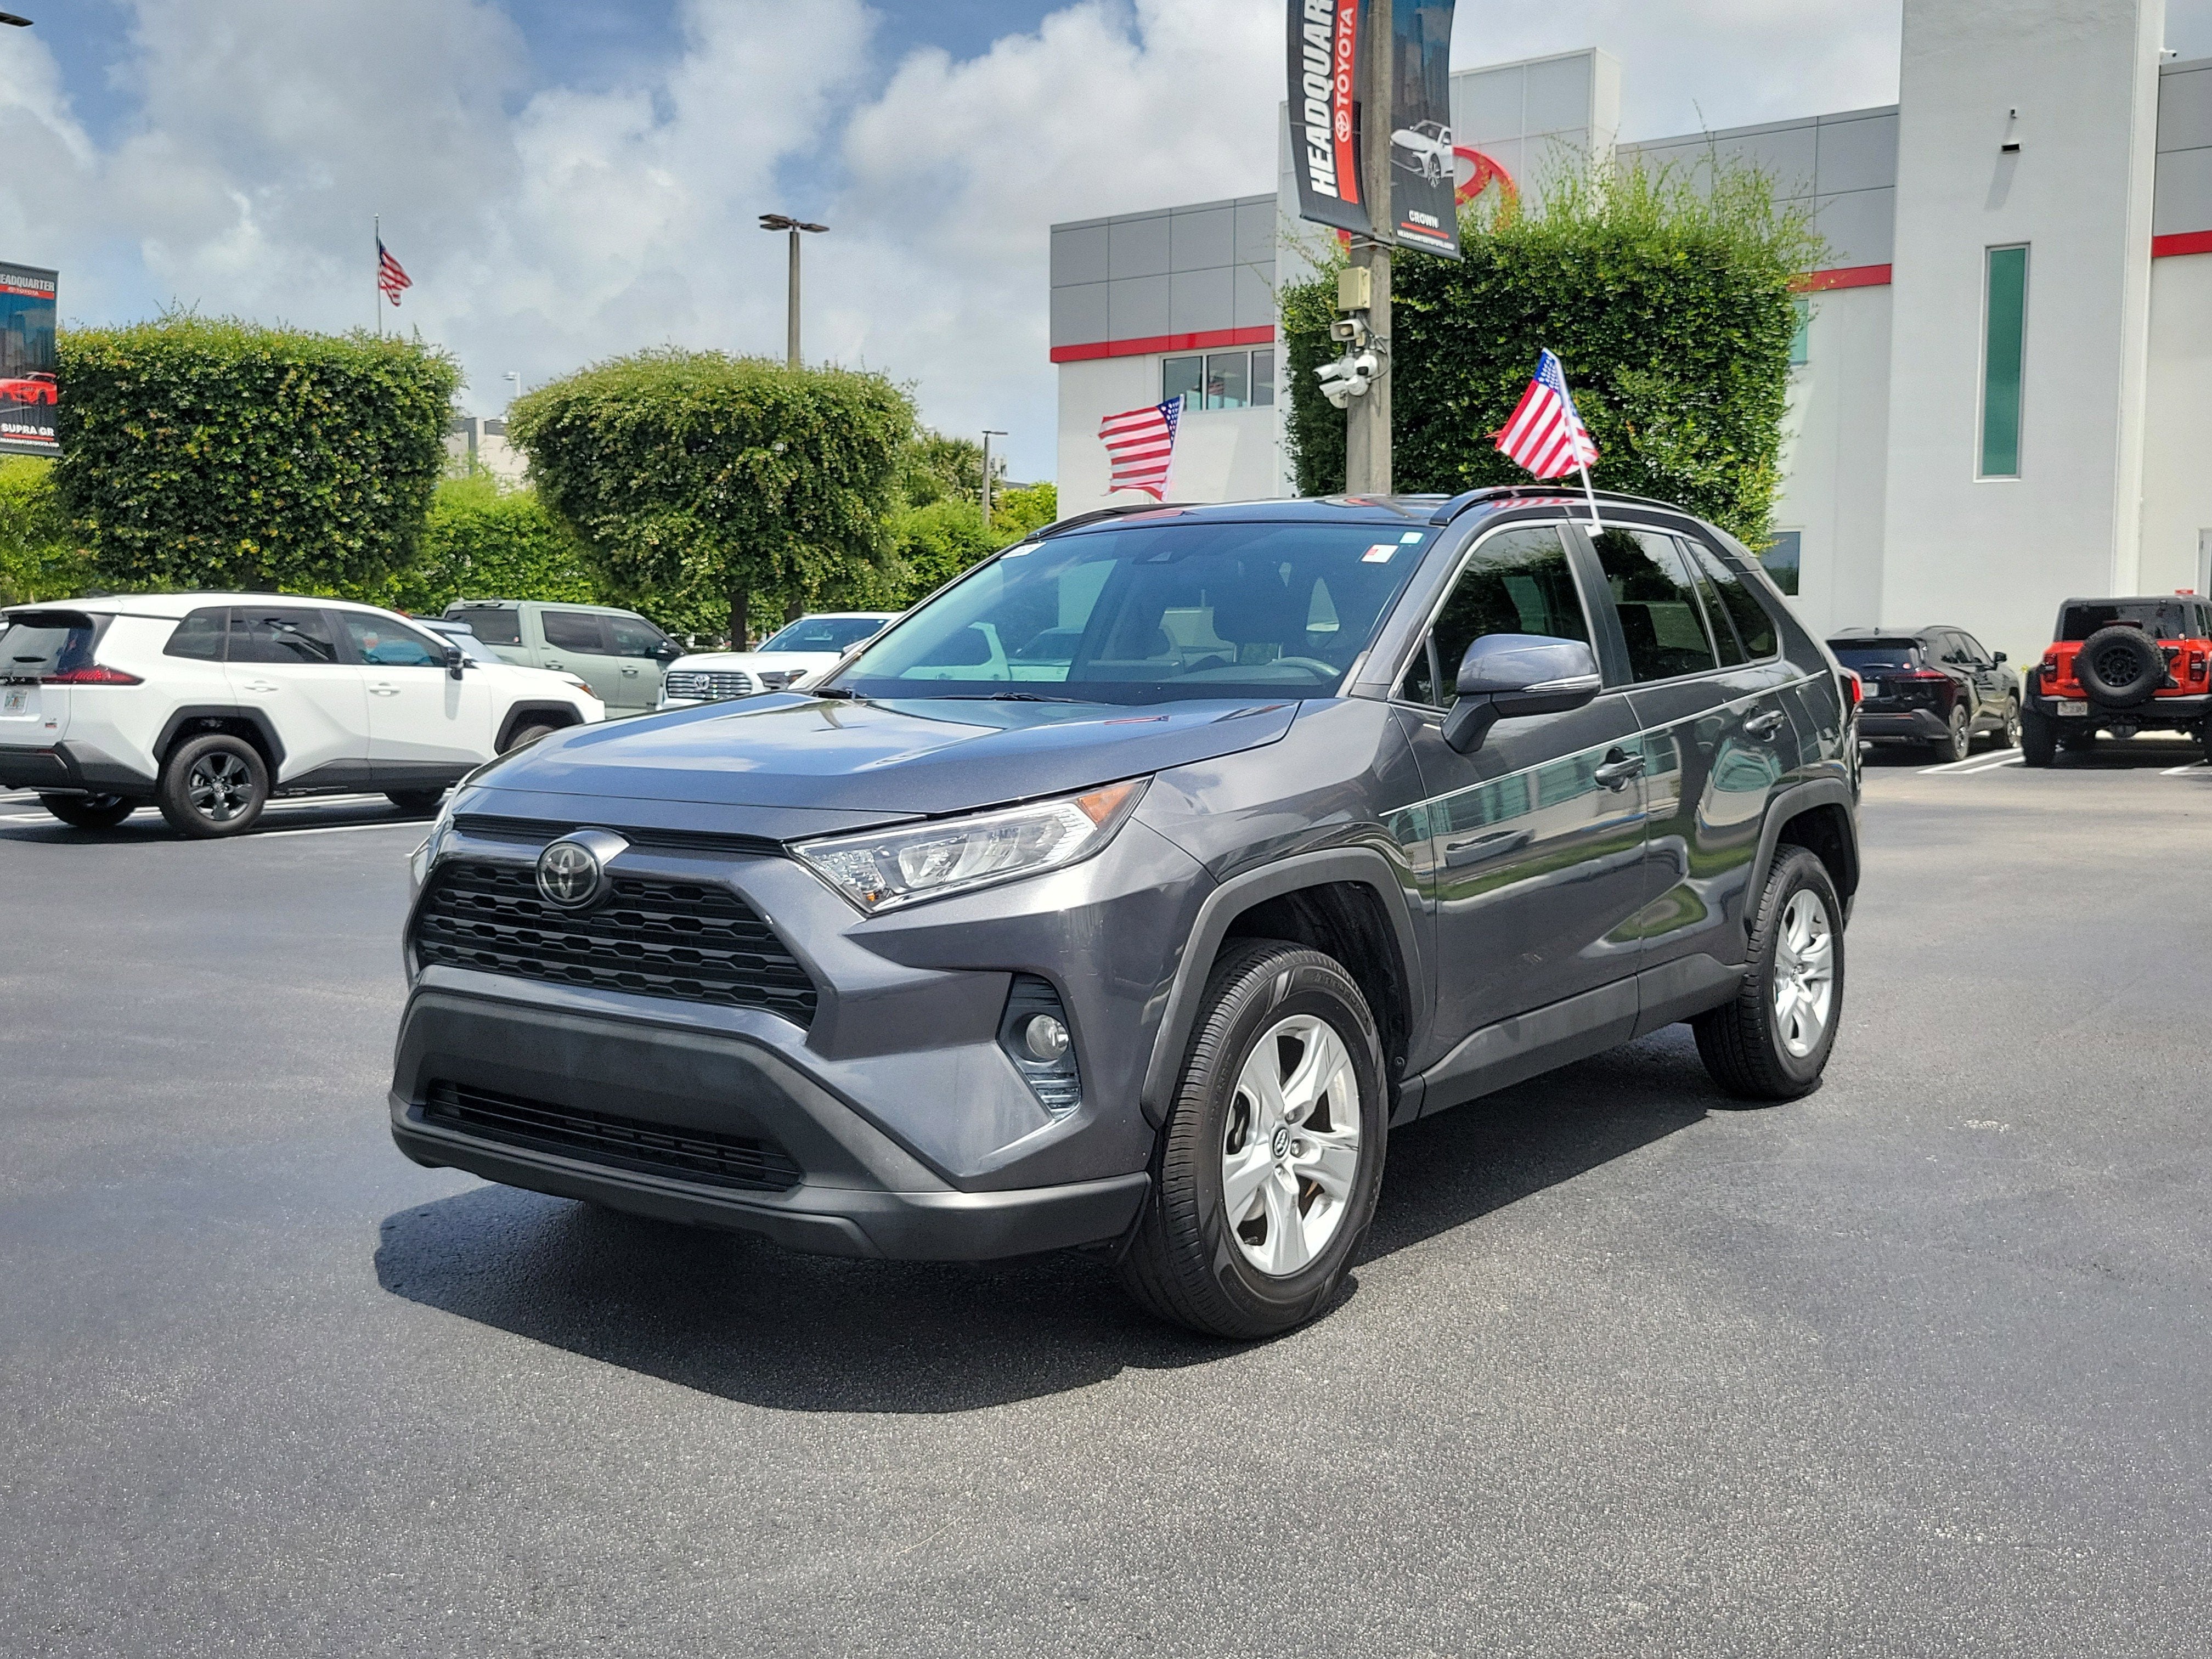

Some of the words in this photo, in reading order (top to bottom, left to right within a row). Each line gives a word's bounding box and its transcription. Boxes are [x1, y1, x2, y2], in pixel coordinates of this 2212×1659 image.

[1337, 8, 1354, 108] TOYOTA
[1303, 0, 1339, 198] HEADQUAR
[1408, 210, 1440, 228] CROWN
[0, 274, 55, 292] EADQUARTER
[1, 423, 37, 435] SUPRA
[38, 427, 55, 437] GR
